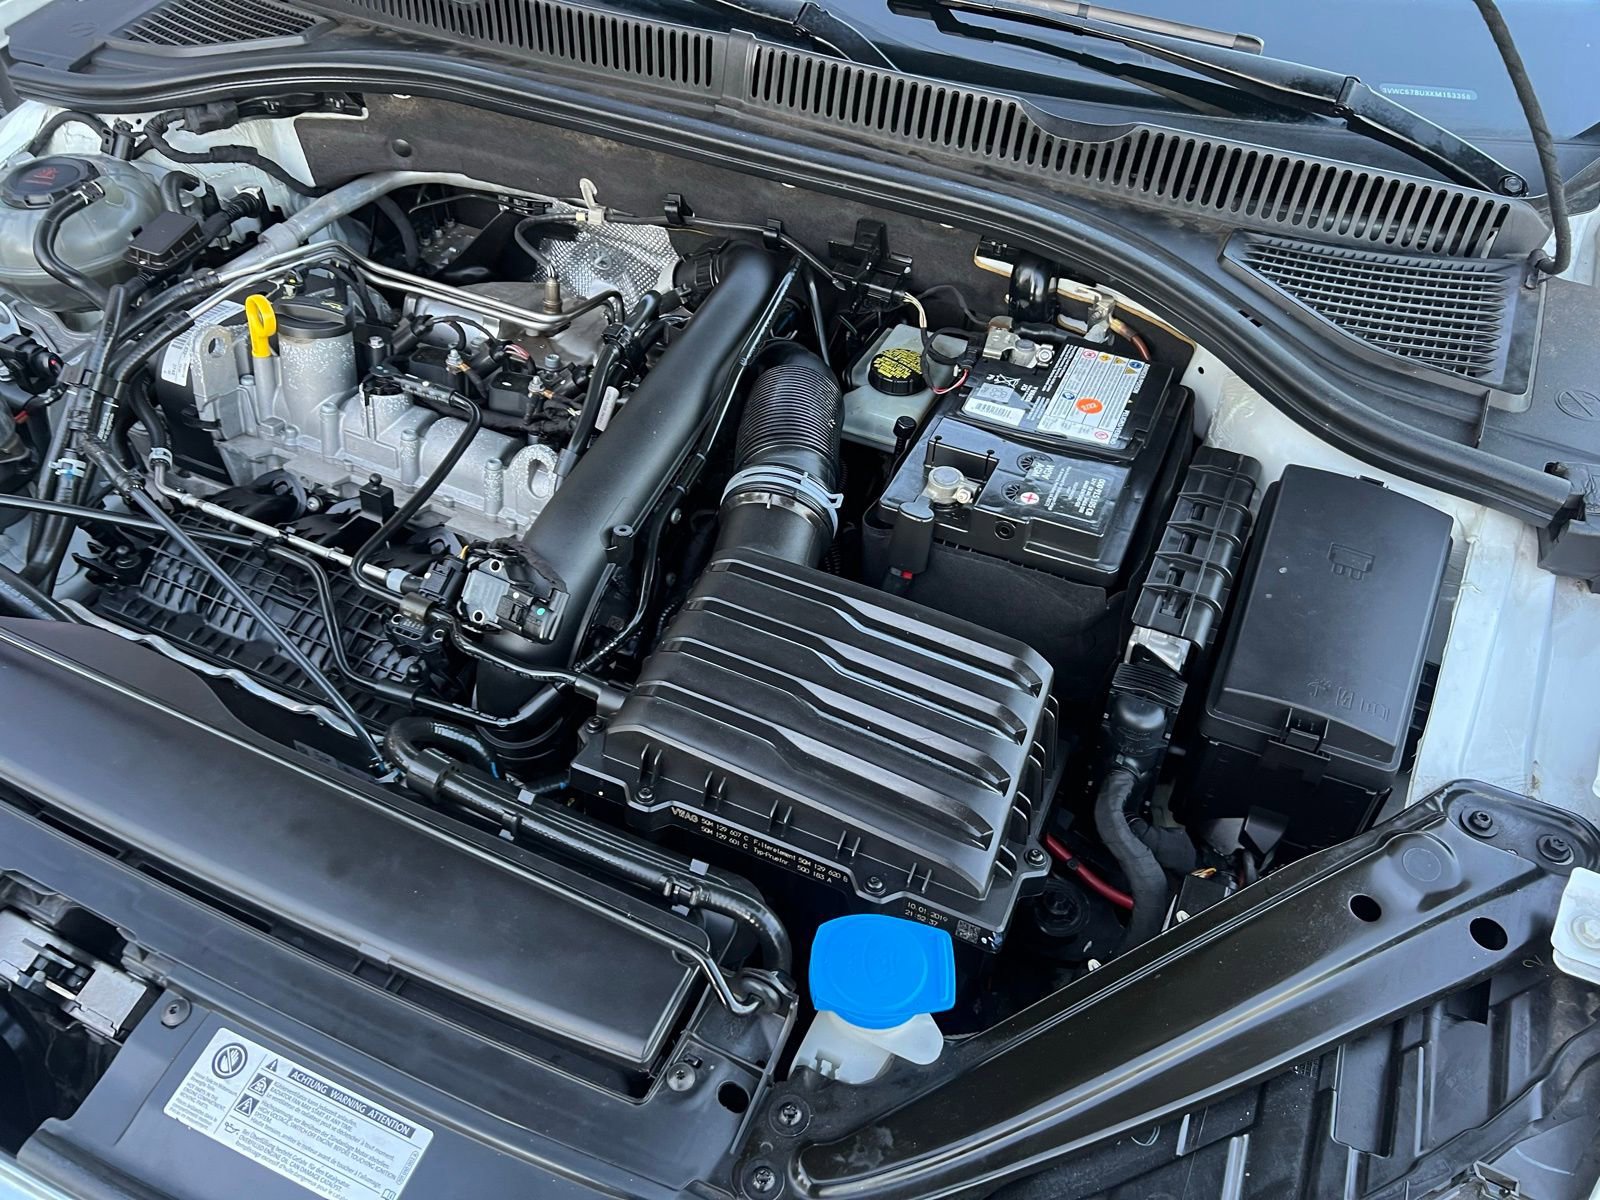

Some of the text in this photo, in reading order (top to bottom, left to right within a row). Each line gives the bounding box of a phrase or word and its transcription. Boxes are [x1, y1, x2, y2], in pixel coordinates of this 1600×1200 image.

[715, 832, 727, 840] 129
[728, 837, 741, 846] 601
[716, 824, 728, 833] 129
[730, 830, 741, 838] 607
[814, 863, 826, 872] 129
[291, 1071, 409, 1134] ACHTUNG WARNING ATTENTION
